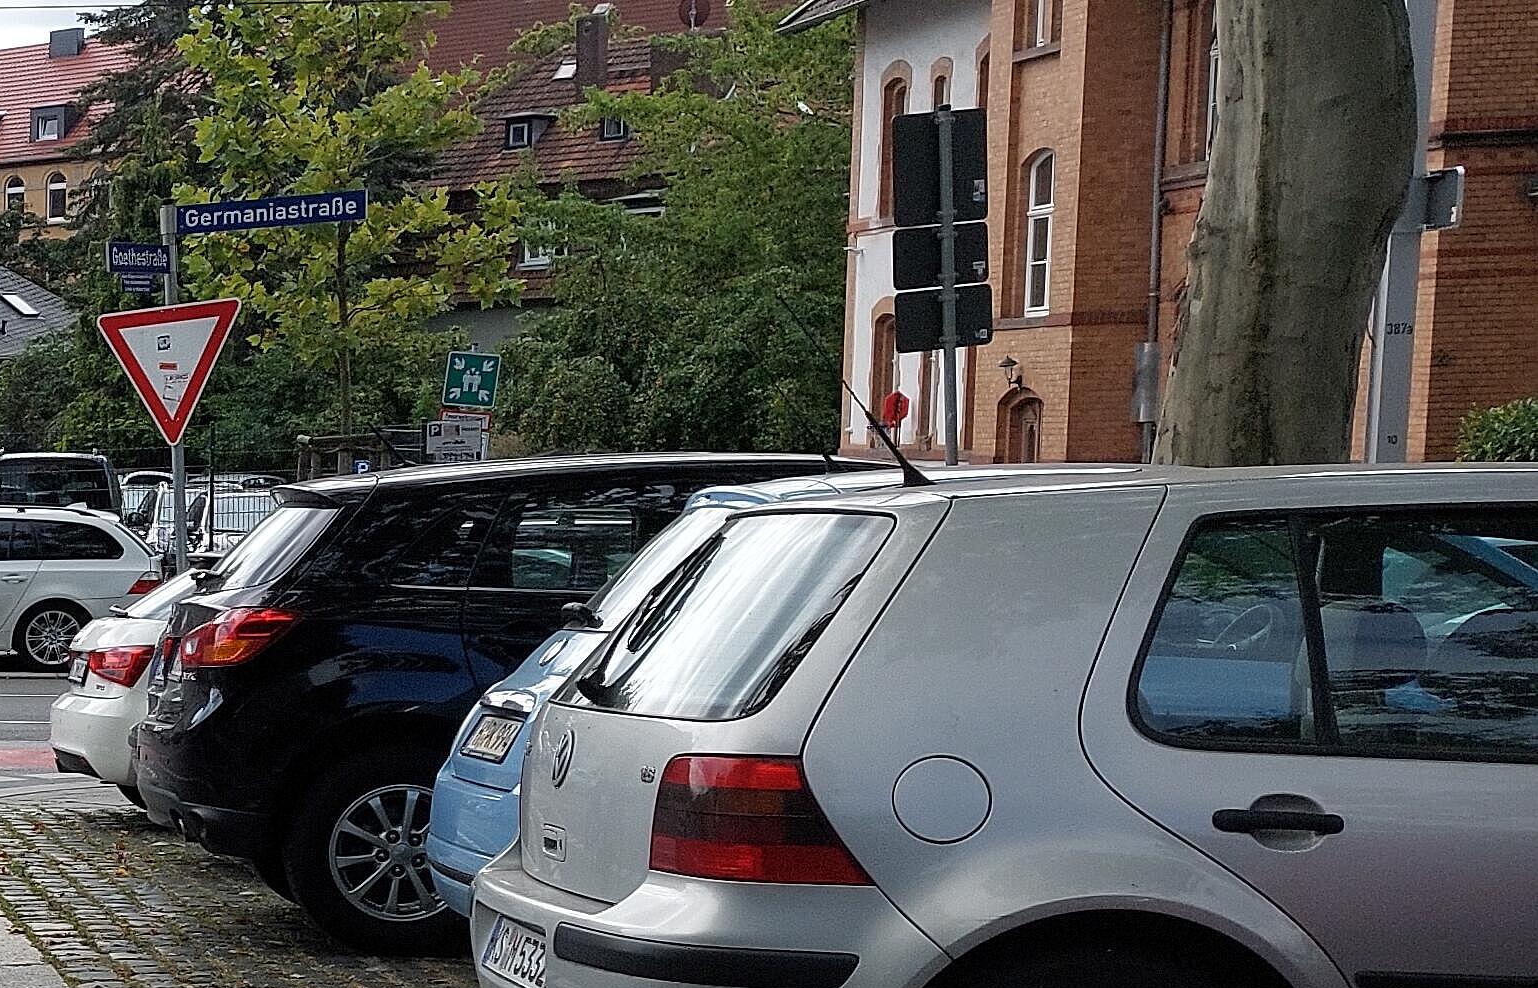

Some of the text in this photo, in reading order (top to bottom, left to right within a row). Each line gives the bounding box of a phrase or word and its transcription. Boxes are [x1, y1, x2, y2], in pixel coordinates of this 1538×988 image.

[185, 196, 357, 227] Germaniastraße
[112, 246, 167, 268] Goethestraße
[357, 463, 368, 474] P
